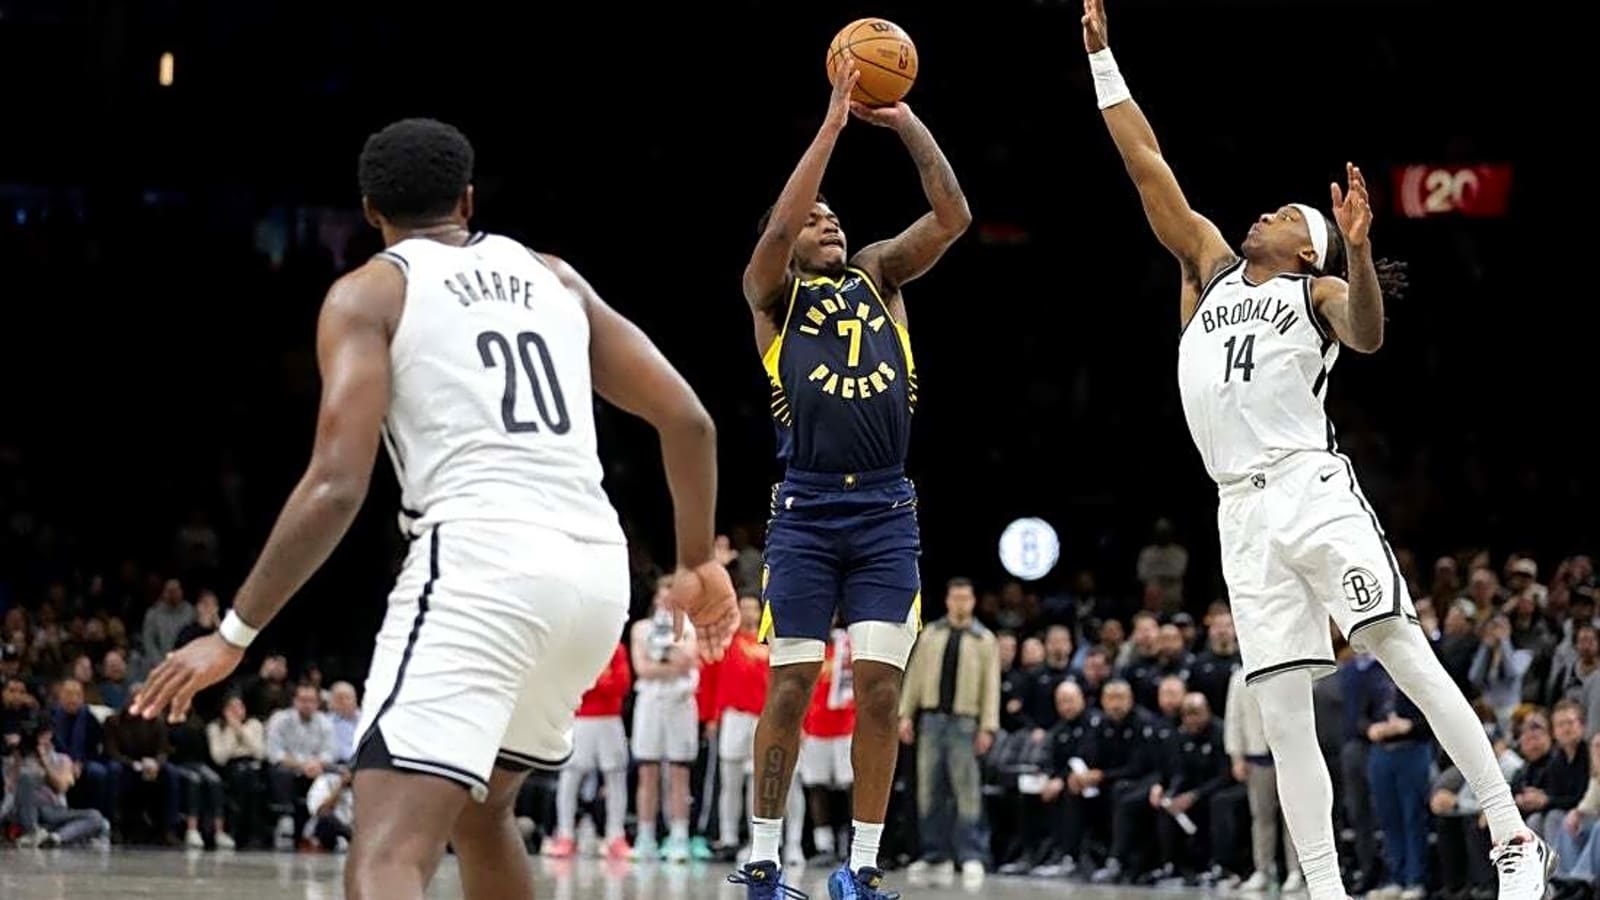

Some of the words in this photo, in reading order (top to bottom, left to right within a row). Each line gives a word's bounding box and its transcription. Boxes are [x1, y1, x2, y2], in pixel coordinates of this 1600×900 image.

[444, 269, 535, 310] SHARPE
[799, 292, 886, 336] INDINA
[1201, 297, 1299, 336] BROOKLYN
[837, 318, 862, 368] 7
[1223, 333, 1256, 383] 14
[476, 330, 571, 436] 20
[808, 361, 896, 400] PACERS
[1350, 574, 1371, 606] B
